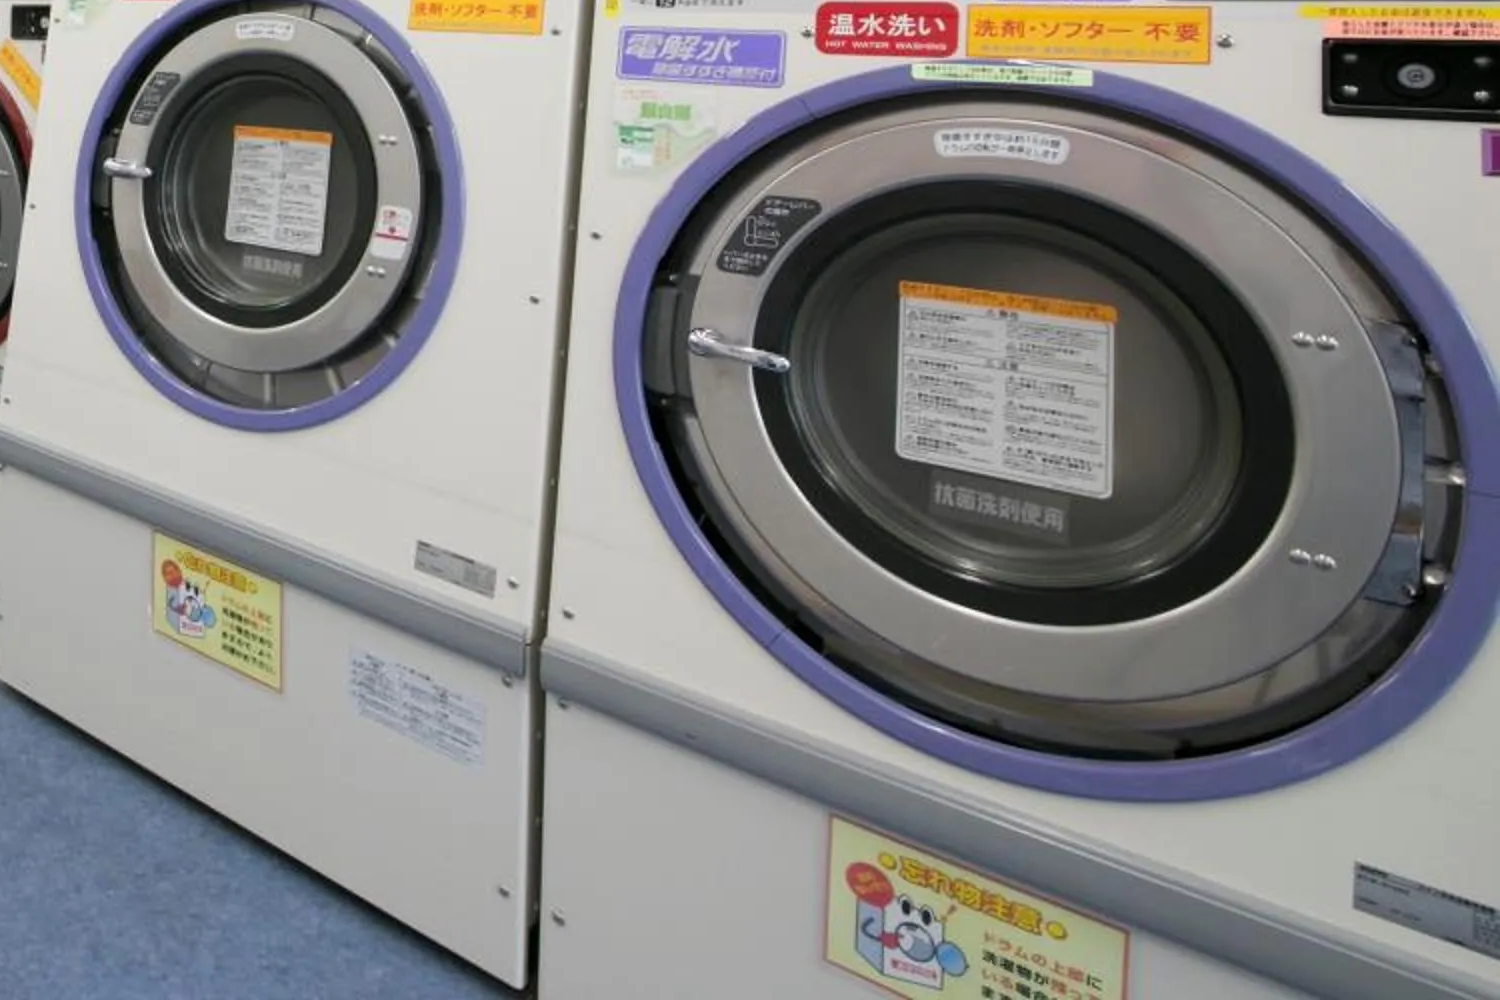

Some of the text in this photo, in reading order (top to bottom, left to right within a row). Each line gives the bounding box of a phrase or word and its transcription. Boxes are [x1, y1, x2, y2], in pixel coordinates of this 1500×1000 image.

[414, 1, 538, 19] 洗剤・ソフター 不要
[827, 12, 948, 38] 温水洗い
[972, 17, 1202, 44] 洗剤・ソフター 不要
[624, 32, 742, 63] 電解水
[825, 40, 948, 51] HOT WATER WASHING
[934, 480, 1065, 534] 抗菌洗剤使用
[899, 854, 1043, 936] 忘れ物注意
[983, 929, 1104, 992] ドラムの上部に
